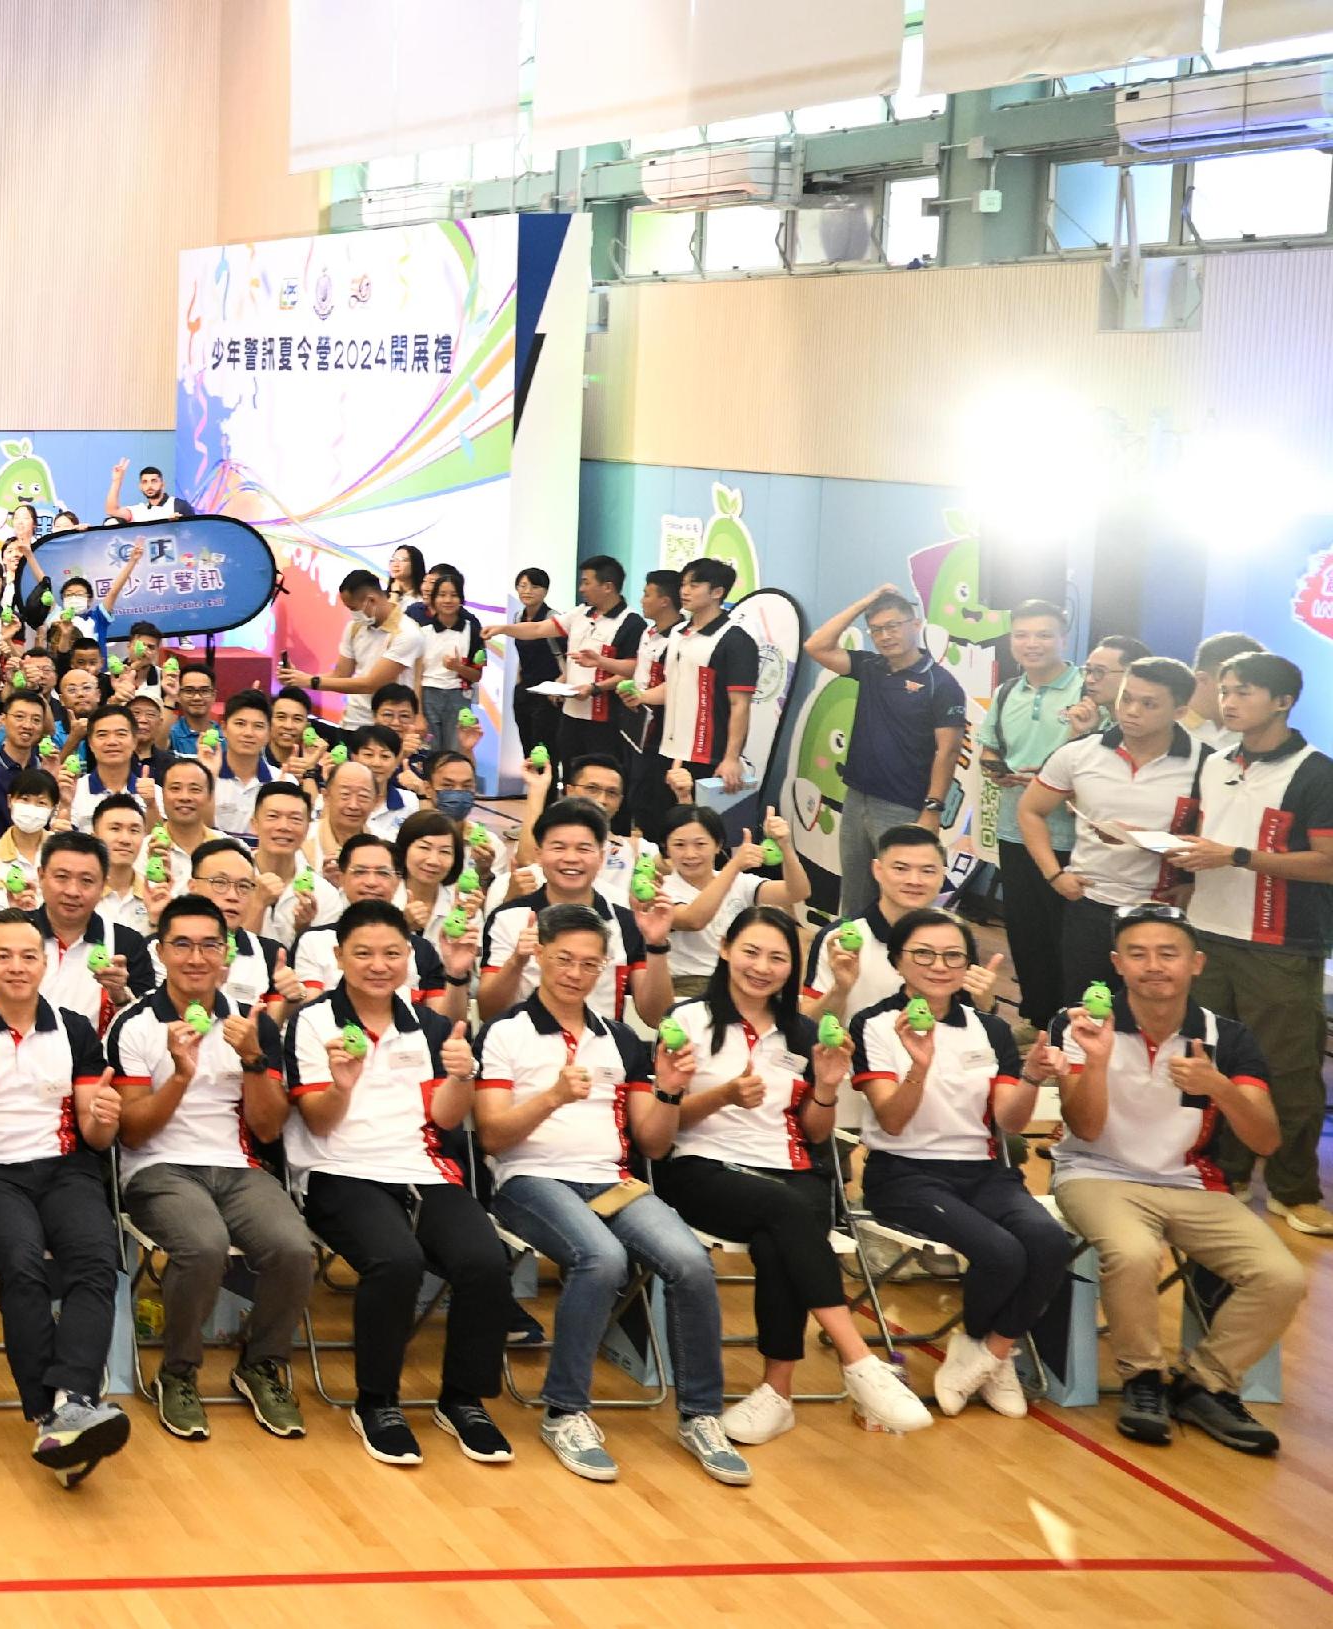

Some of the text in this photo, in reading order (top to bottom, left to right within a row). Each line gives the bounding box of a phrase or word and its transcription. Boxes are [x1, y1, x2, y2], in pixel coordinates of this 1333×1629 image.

[211, 334, 453, 374] 少年警訊夏令營2024開展禮
[95, 569, 225, 598] 區少年警訊
